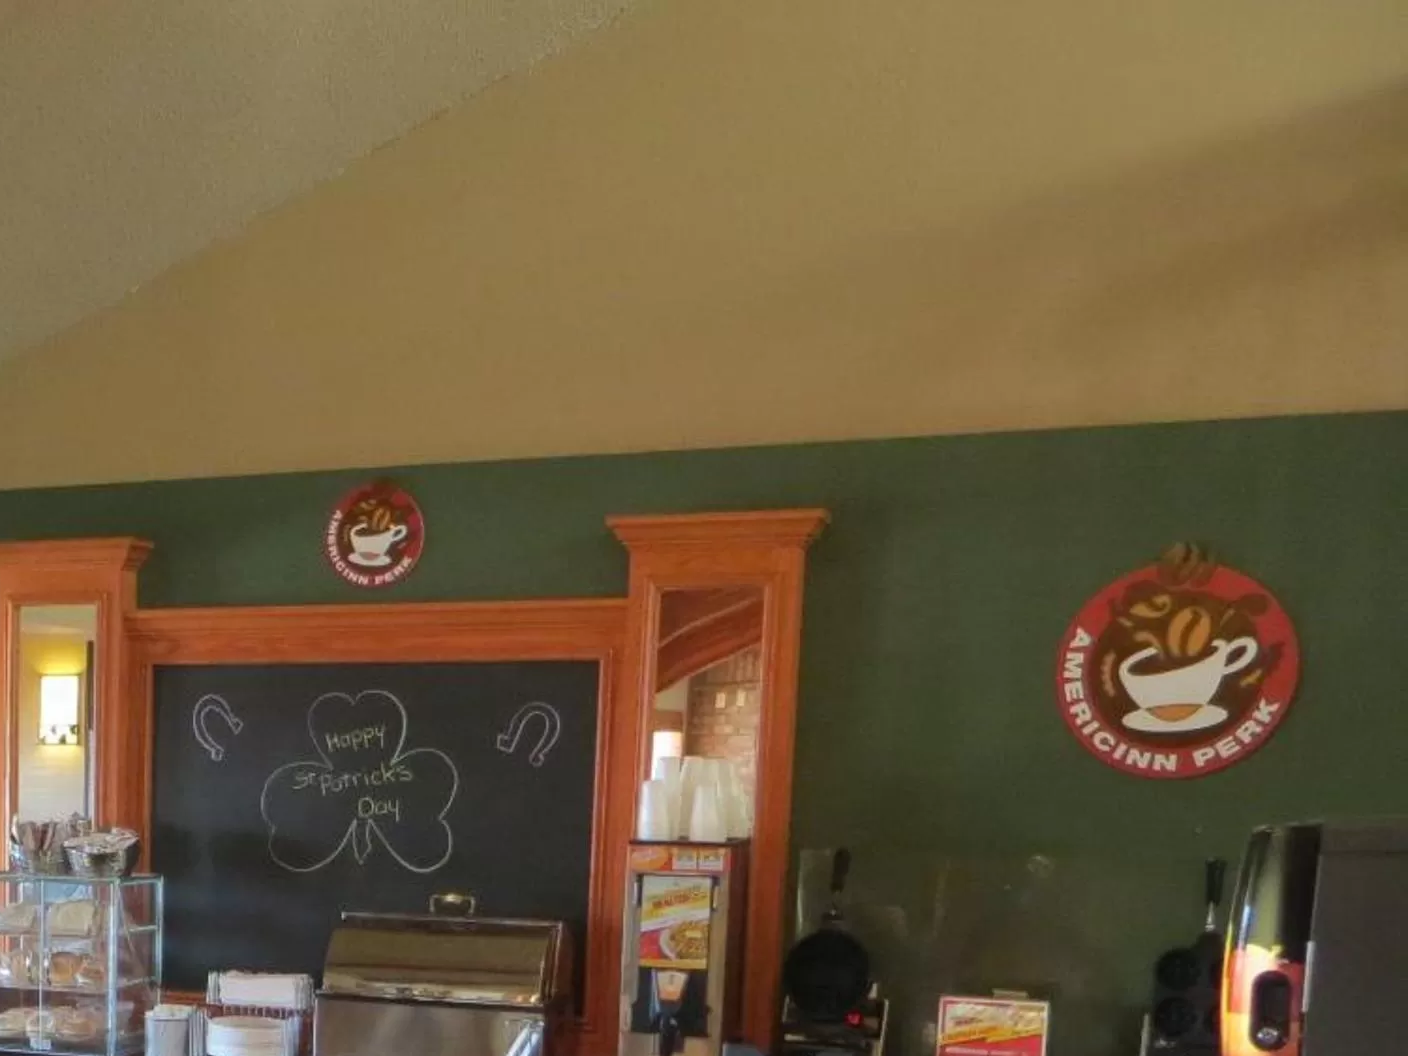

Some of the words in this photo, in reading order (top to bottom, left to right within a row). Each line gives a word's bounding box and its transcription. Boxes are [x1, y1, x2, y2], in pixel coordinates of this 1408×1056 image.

[1063, 627, 1178, 773] AMERICINN
[1193, 697, 1280, 768] PERK
[325, 722, 386, 752] Happy
[358, 797, 400, 823] Day
